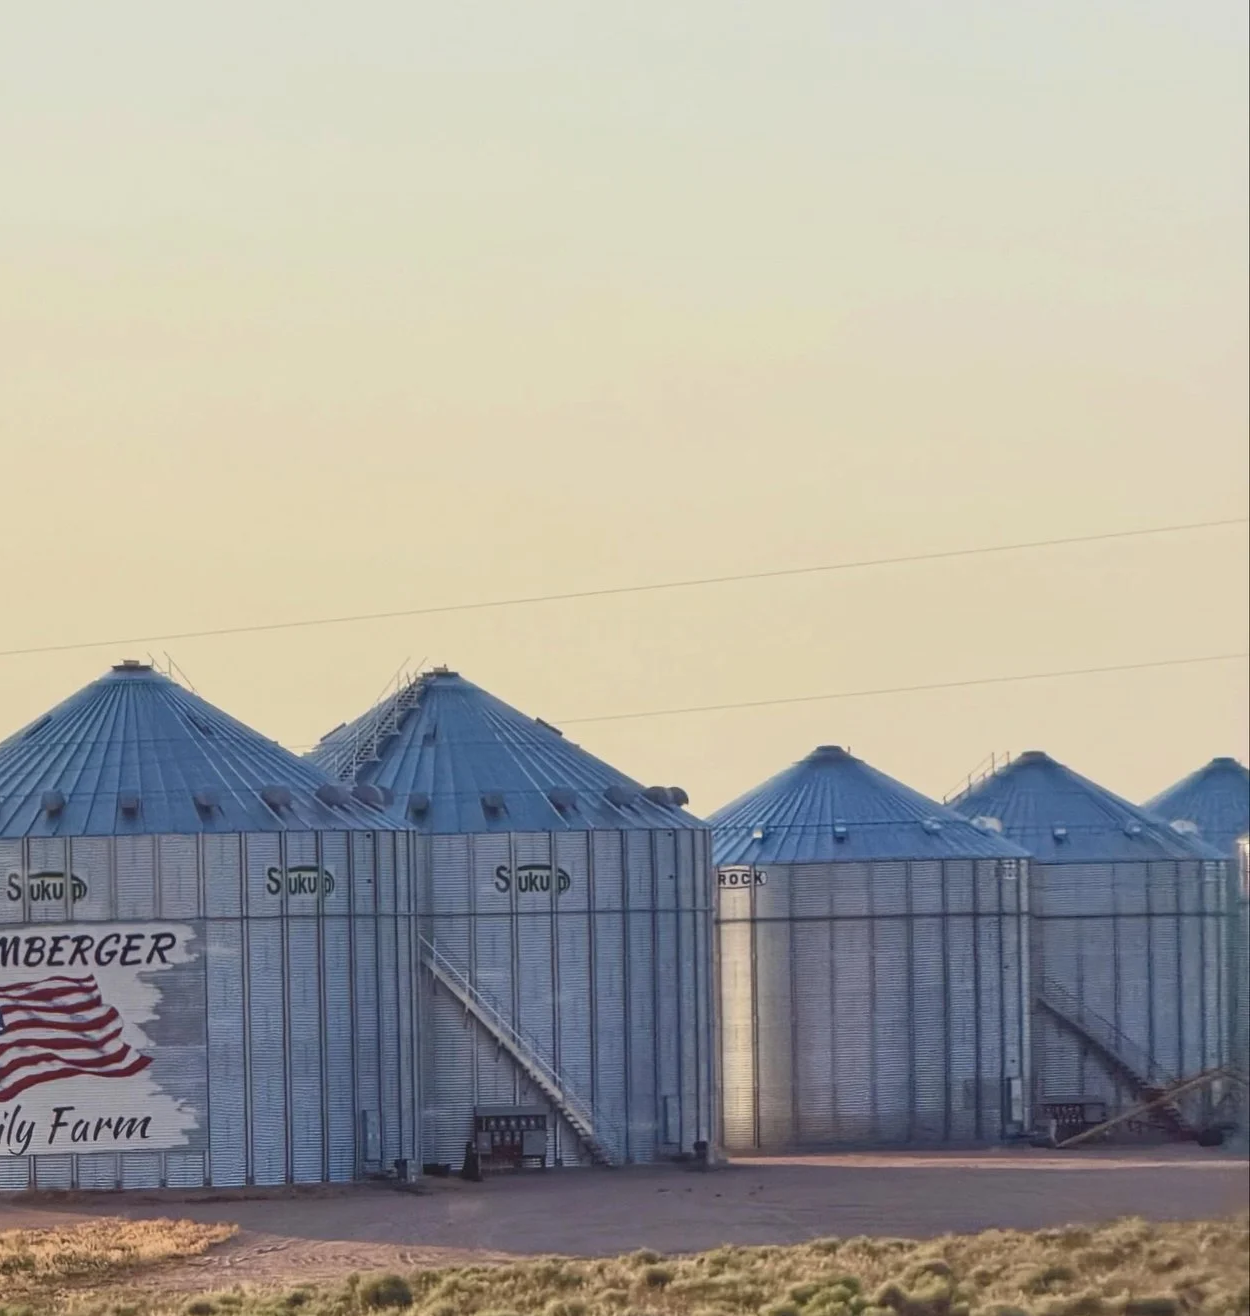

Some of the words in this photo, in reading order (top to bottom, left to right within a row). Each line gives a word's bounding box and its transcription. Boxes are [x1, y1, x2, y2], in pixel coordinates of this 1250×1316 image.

[6, 872, 85, 904] Sukup
[494, 865, 568, 895] Sukup
[48, 1106, 152, 1144] Farm
